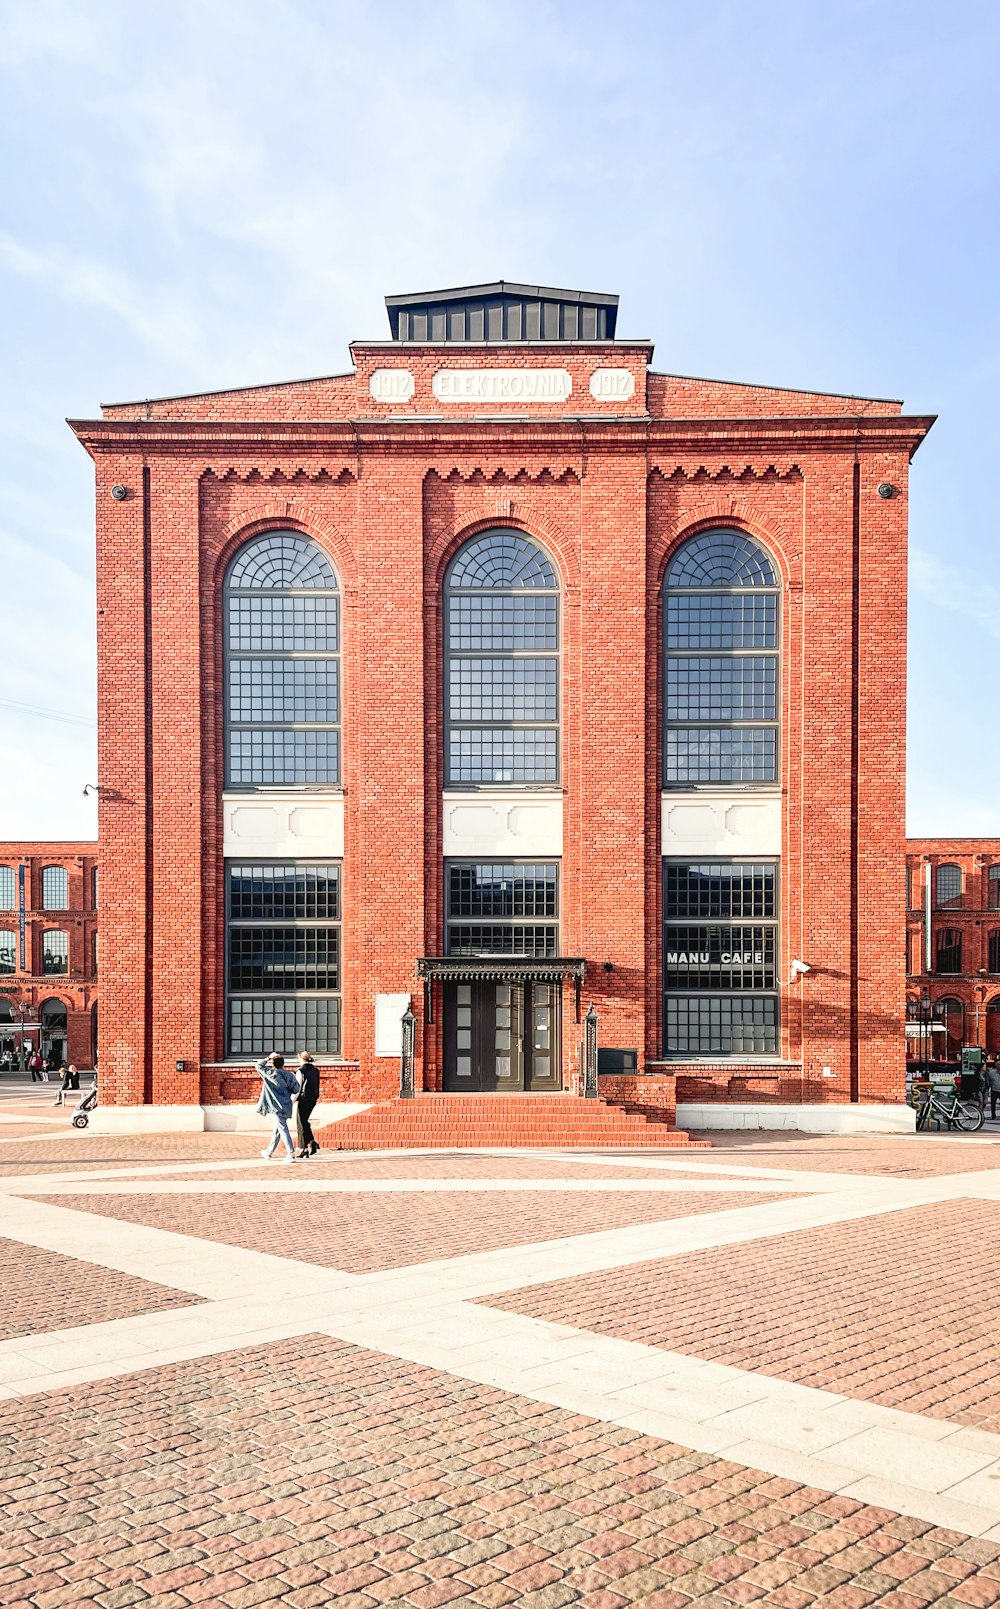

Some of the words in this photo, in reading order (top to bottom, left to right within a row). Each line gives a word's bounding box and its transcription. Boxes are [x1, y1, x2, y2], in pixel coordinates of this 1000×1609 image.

[375, 374, 410, 397] 1912
[439, 374, 567, 397] ELEKTROWNIA
[595, 373, 630, 396] 1912
[667, 952, 710, 964] MANU
[720, 952, 764, 964] CAFE
[906, 1070, 922, 1078] ark
